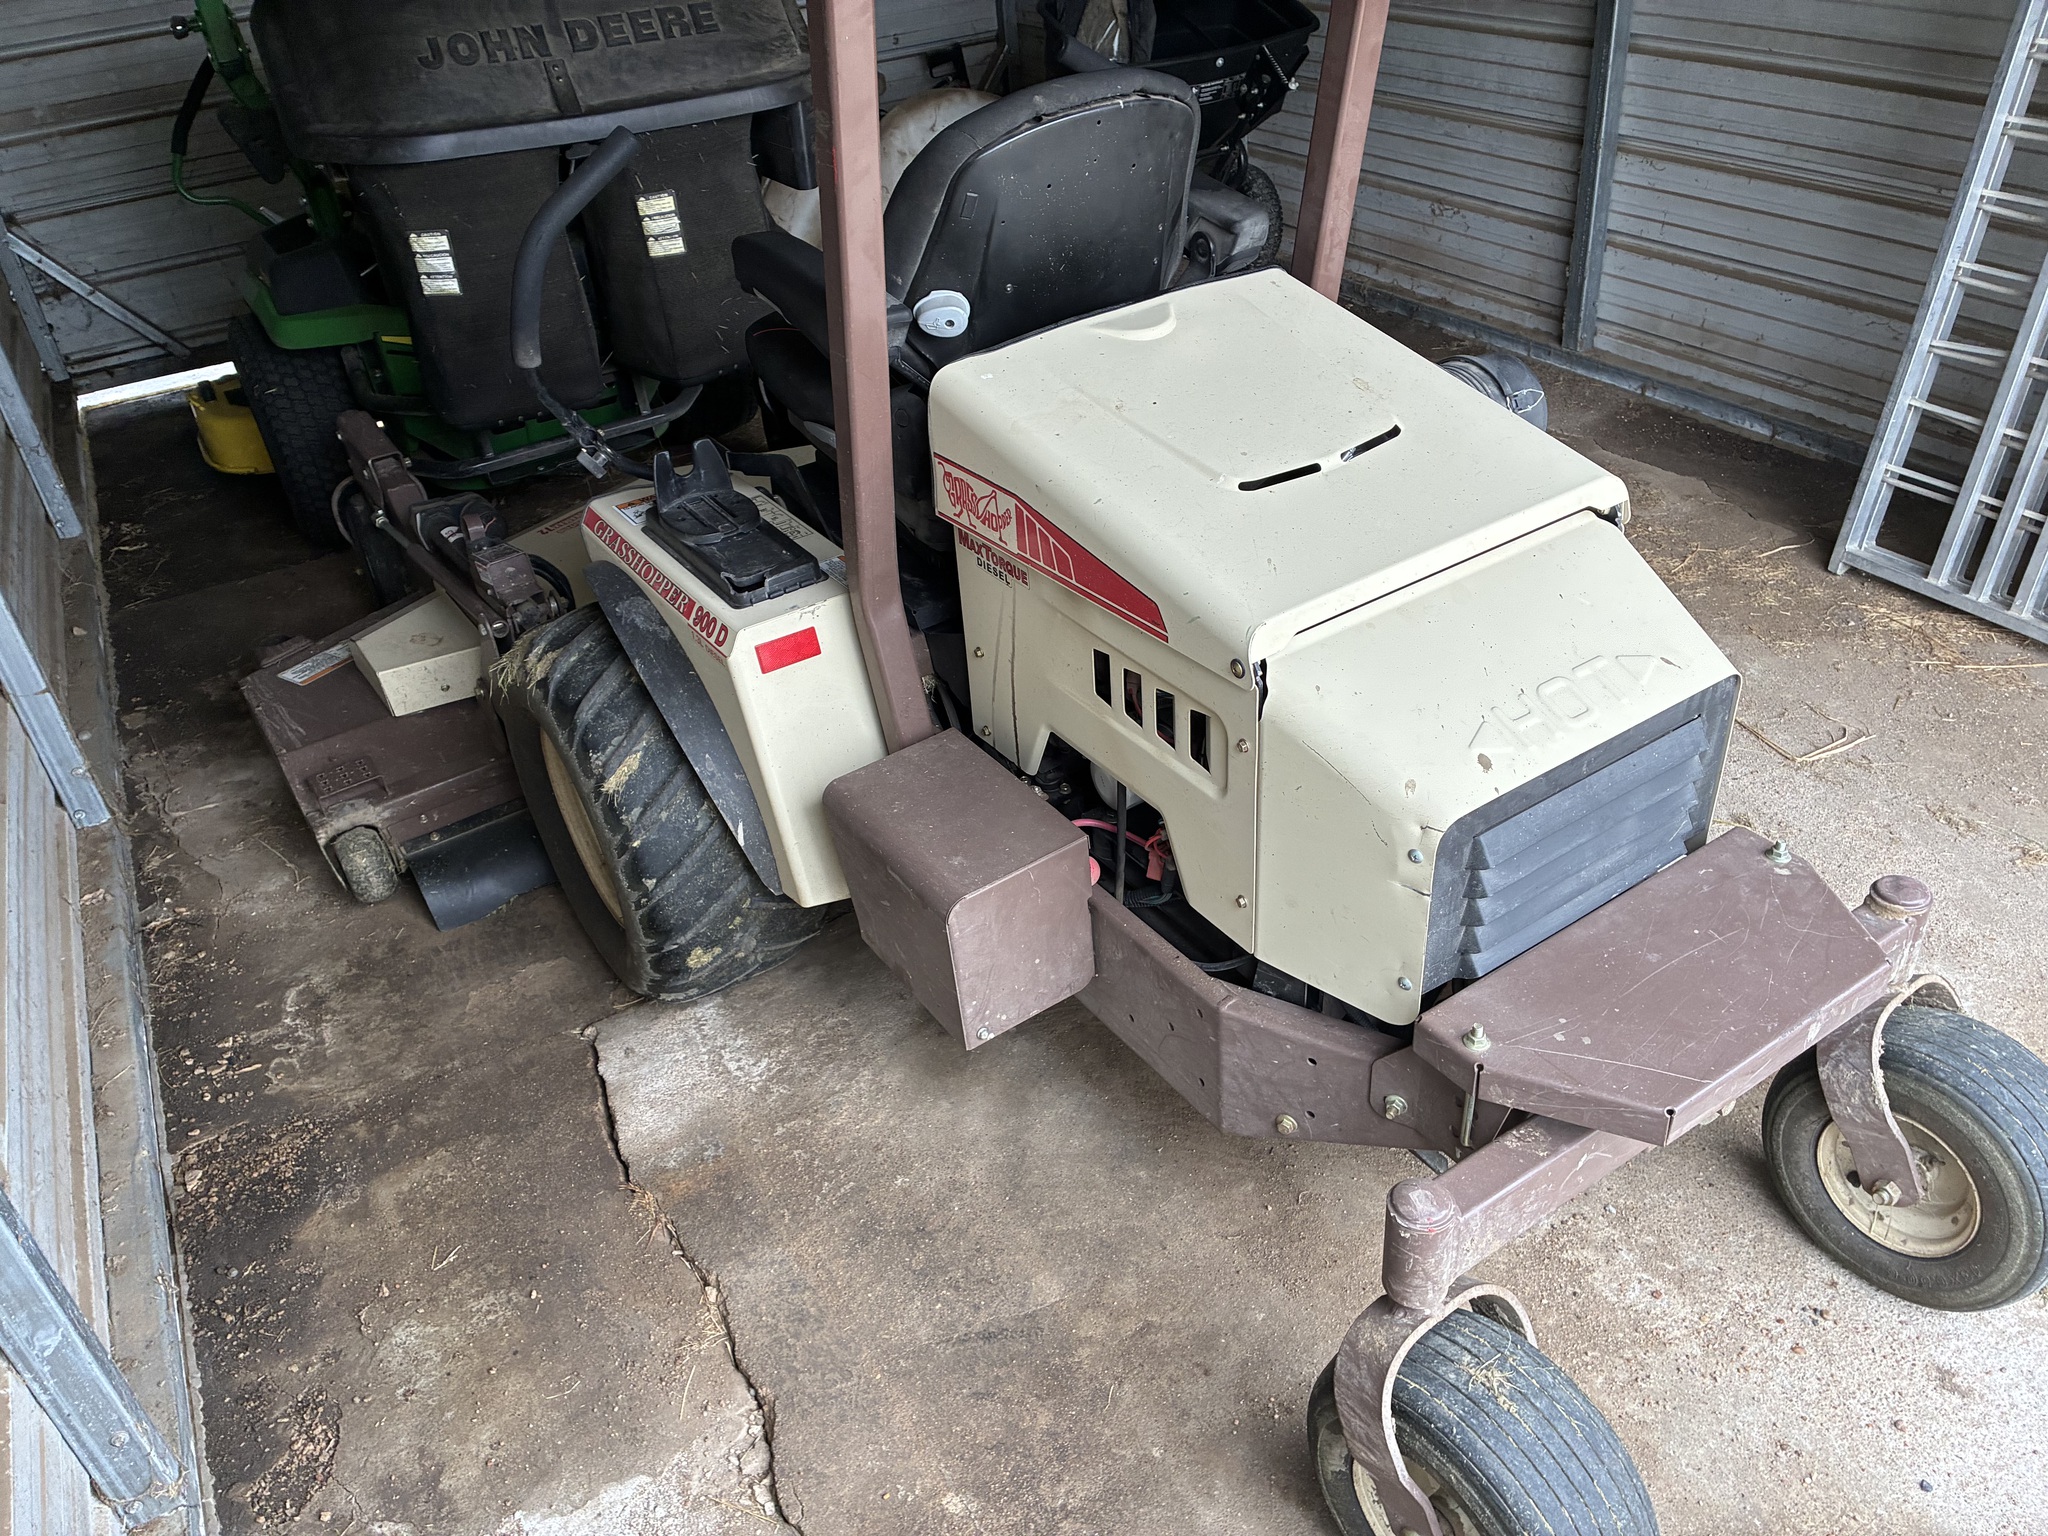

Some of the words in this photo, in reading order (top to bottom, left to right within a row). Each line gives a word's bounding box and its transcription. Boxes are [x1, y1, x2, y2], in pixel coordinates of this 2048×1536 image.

[417, 24, 552, 70] JOHN
[561, 2, 721, 53] DEERE
[593, 519, 690, 614] GRASSHOPPER
[692, 605, 718, 639] 900
[714, 622, 729, 648] D
[976, 556, 1011, 585] DIESEL
[1490, 655, 1631, 747] HOT
